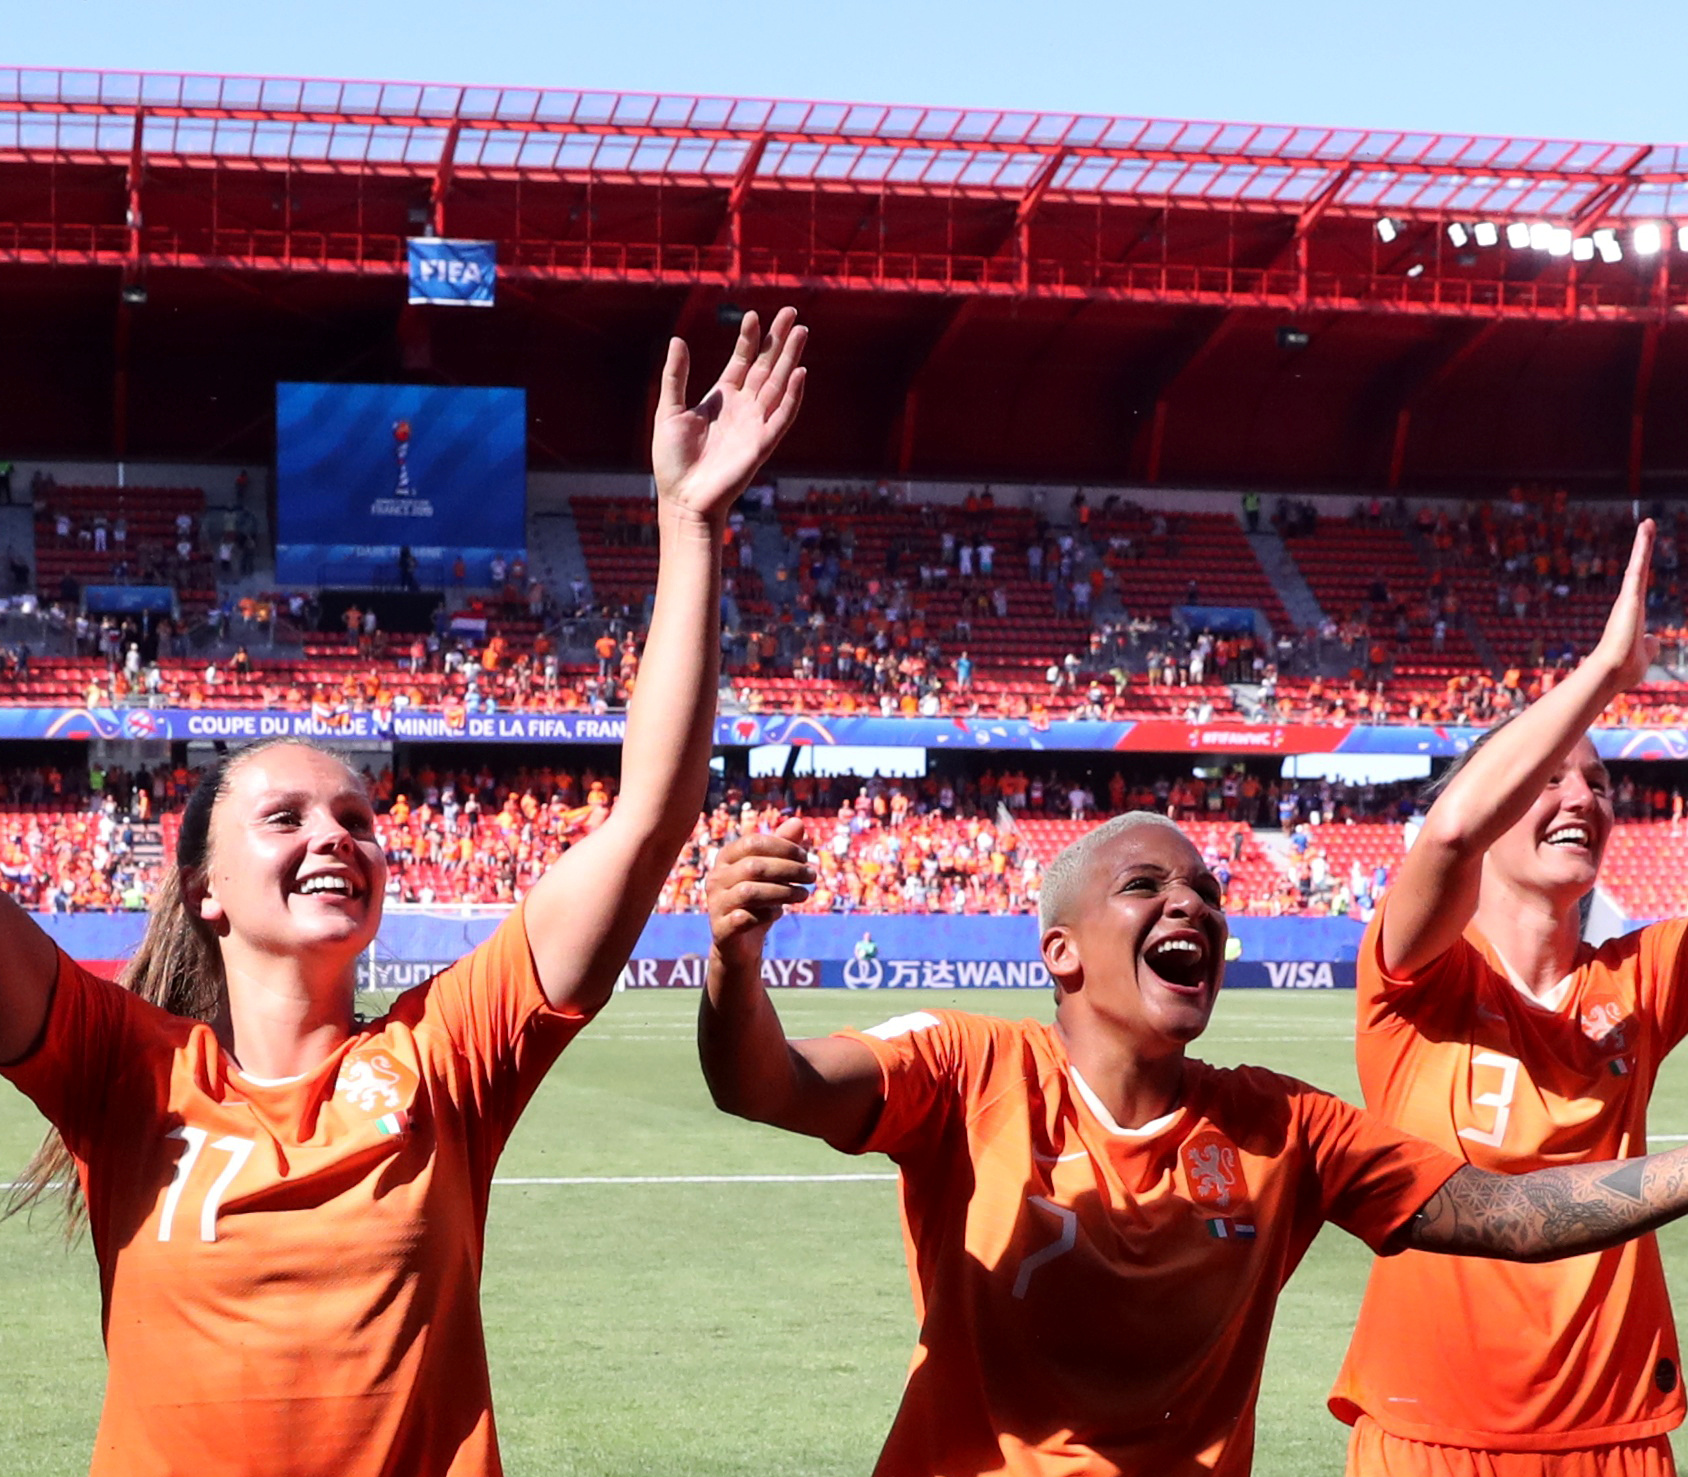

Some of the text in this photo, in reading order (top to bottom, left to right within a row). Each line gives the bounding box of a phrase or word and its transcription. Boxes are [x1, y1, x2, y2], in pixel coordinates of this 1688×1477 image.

[419, 257, 482, 285] FIFA
[188, 715, 257, 734] COUPE
[261, 717, 289, 735] DU
[294, 717, 367, 736] MODE
[469, 718, 495, 736] DE
[499, 719, 525, 737] LA
[528, 719, 572, 739] FIFA,
[576, 720, 625, 739] FRAN
[357, 962, 448, 984] HYUN
[1264, 962, 1335, 988] VISA
[1457, 1052, 1521, 1149] 3
[1012, 1194, 1078, 1301] 7
